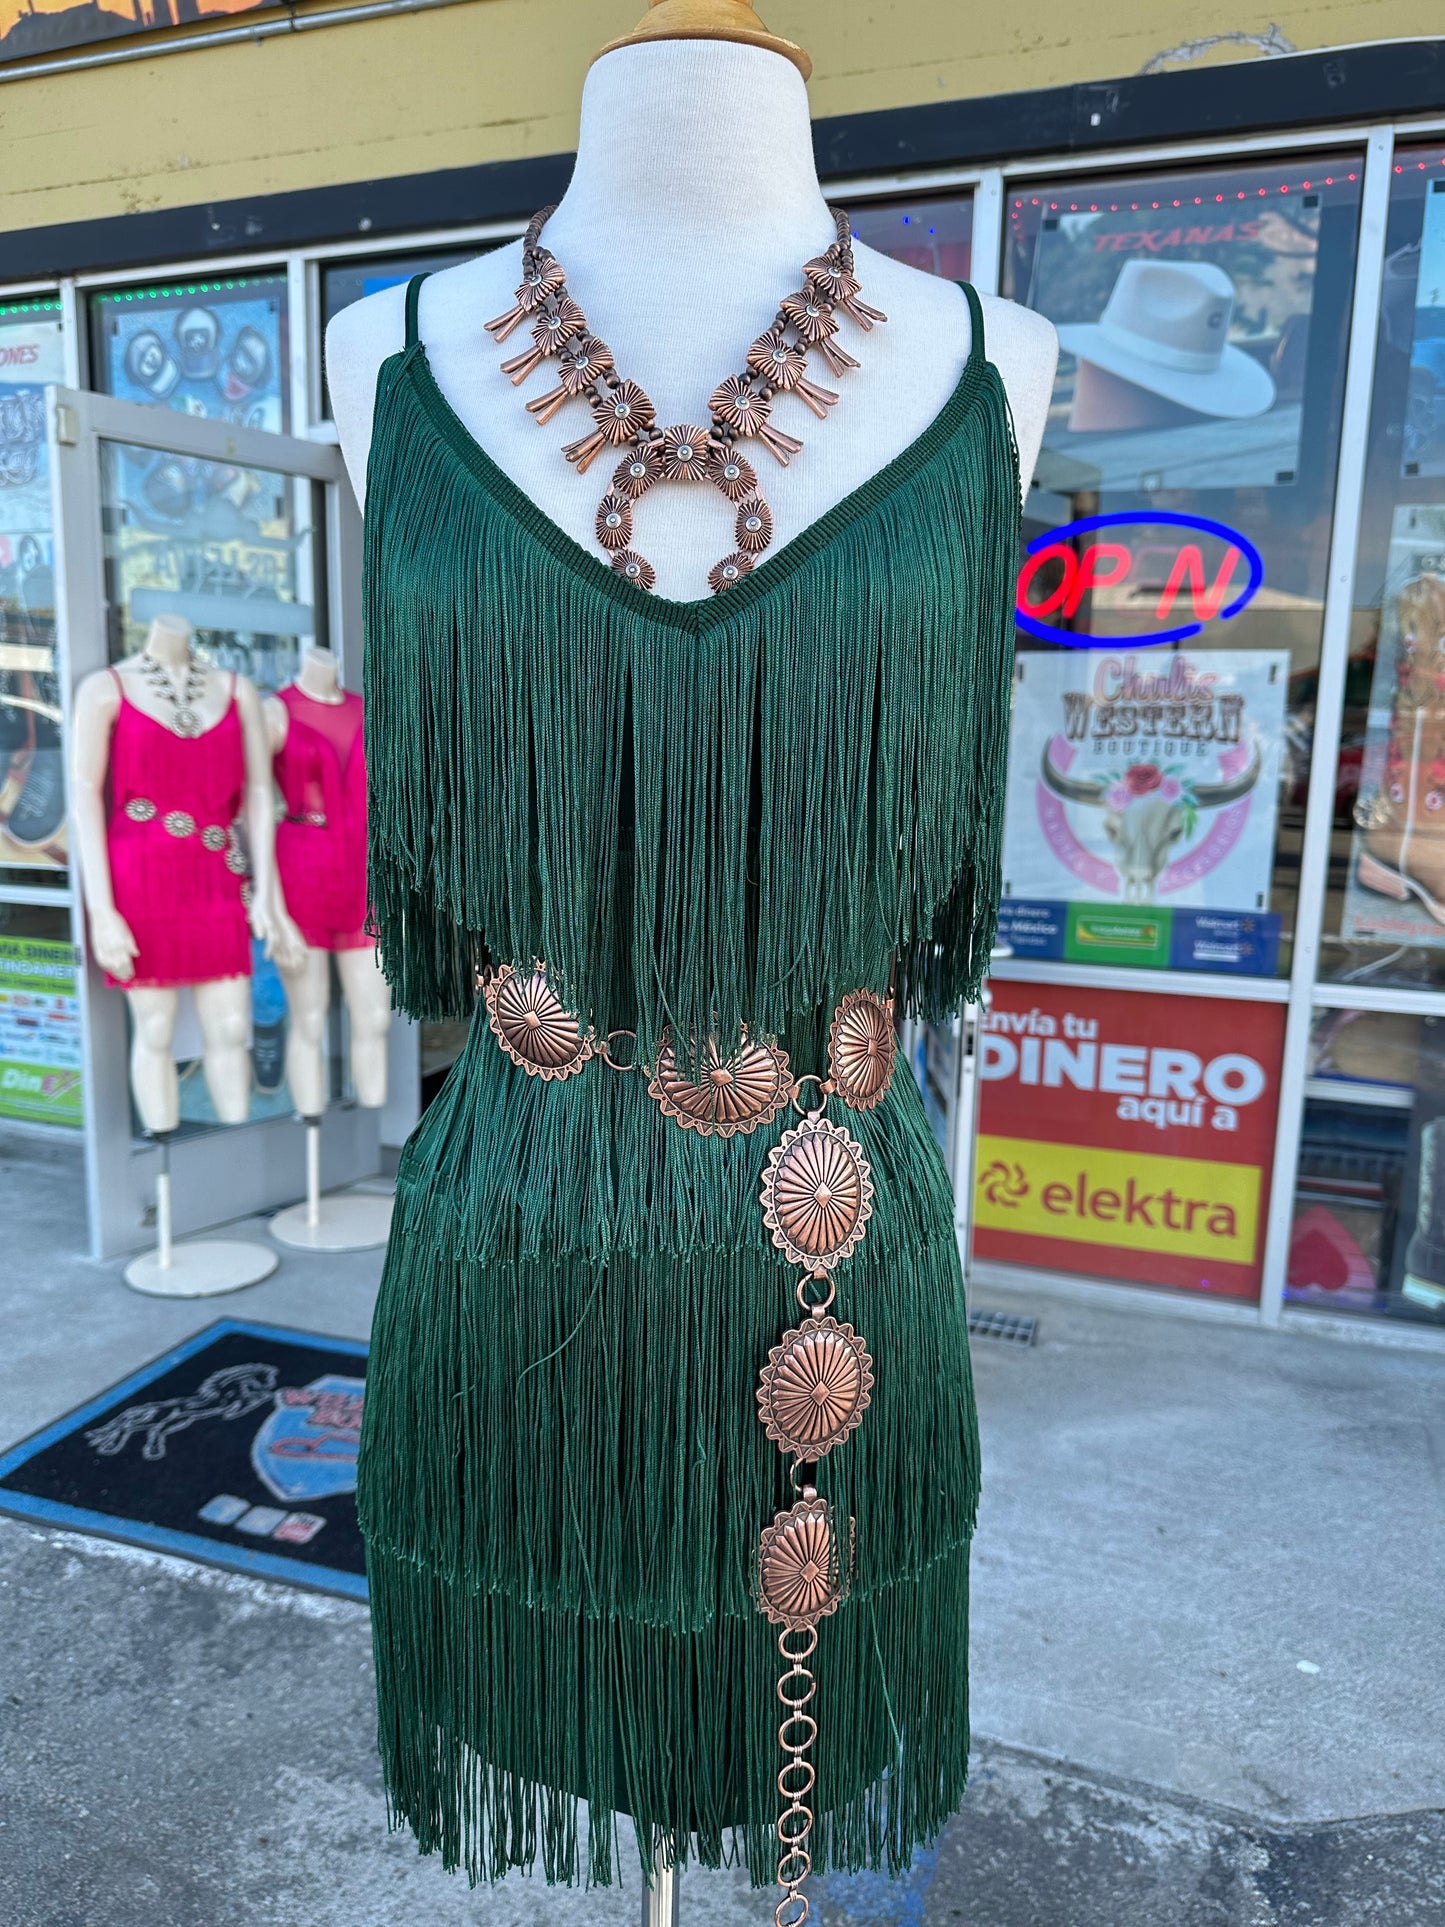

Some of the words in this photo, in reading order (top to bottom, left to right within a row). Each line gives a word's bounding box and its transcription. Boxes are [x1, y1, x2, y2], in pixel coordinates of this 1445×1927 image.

[1092, 220, 1262, 253] TEXANAS
[1062, 691, 1245, 743] WESTERN
[1093, 739, 1210, 757] BOUTIQUE
[981, 1007, 1057, 1036] Envía
[1062, 1012, 1098, 1040] tu
[980, 1033, 1267, 1107] DINERO
[1116, 1094, 1206, 1129] aquí
[1211, 1104, 1238, 1132] a
[1041, 1169, 1237, 1238] elektra
